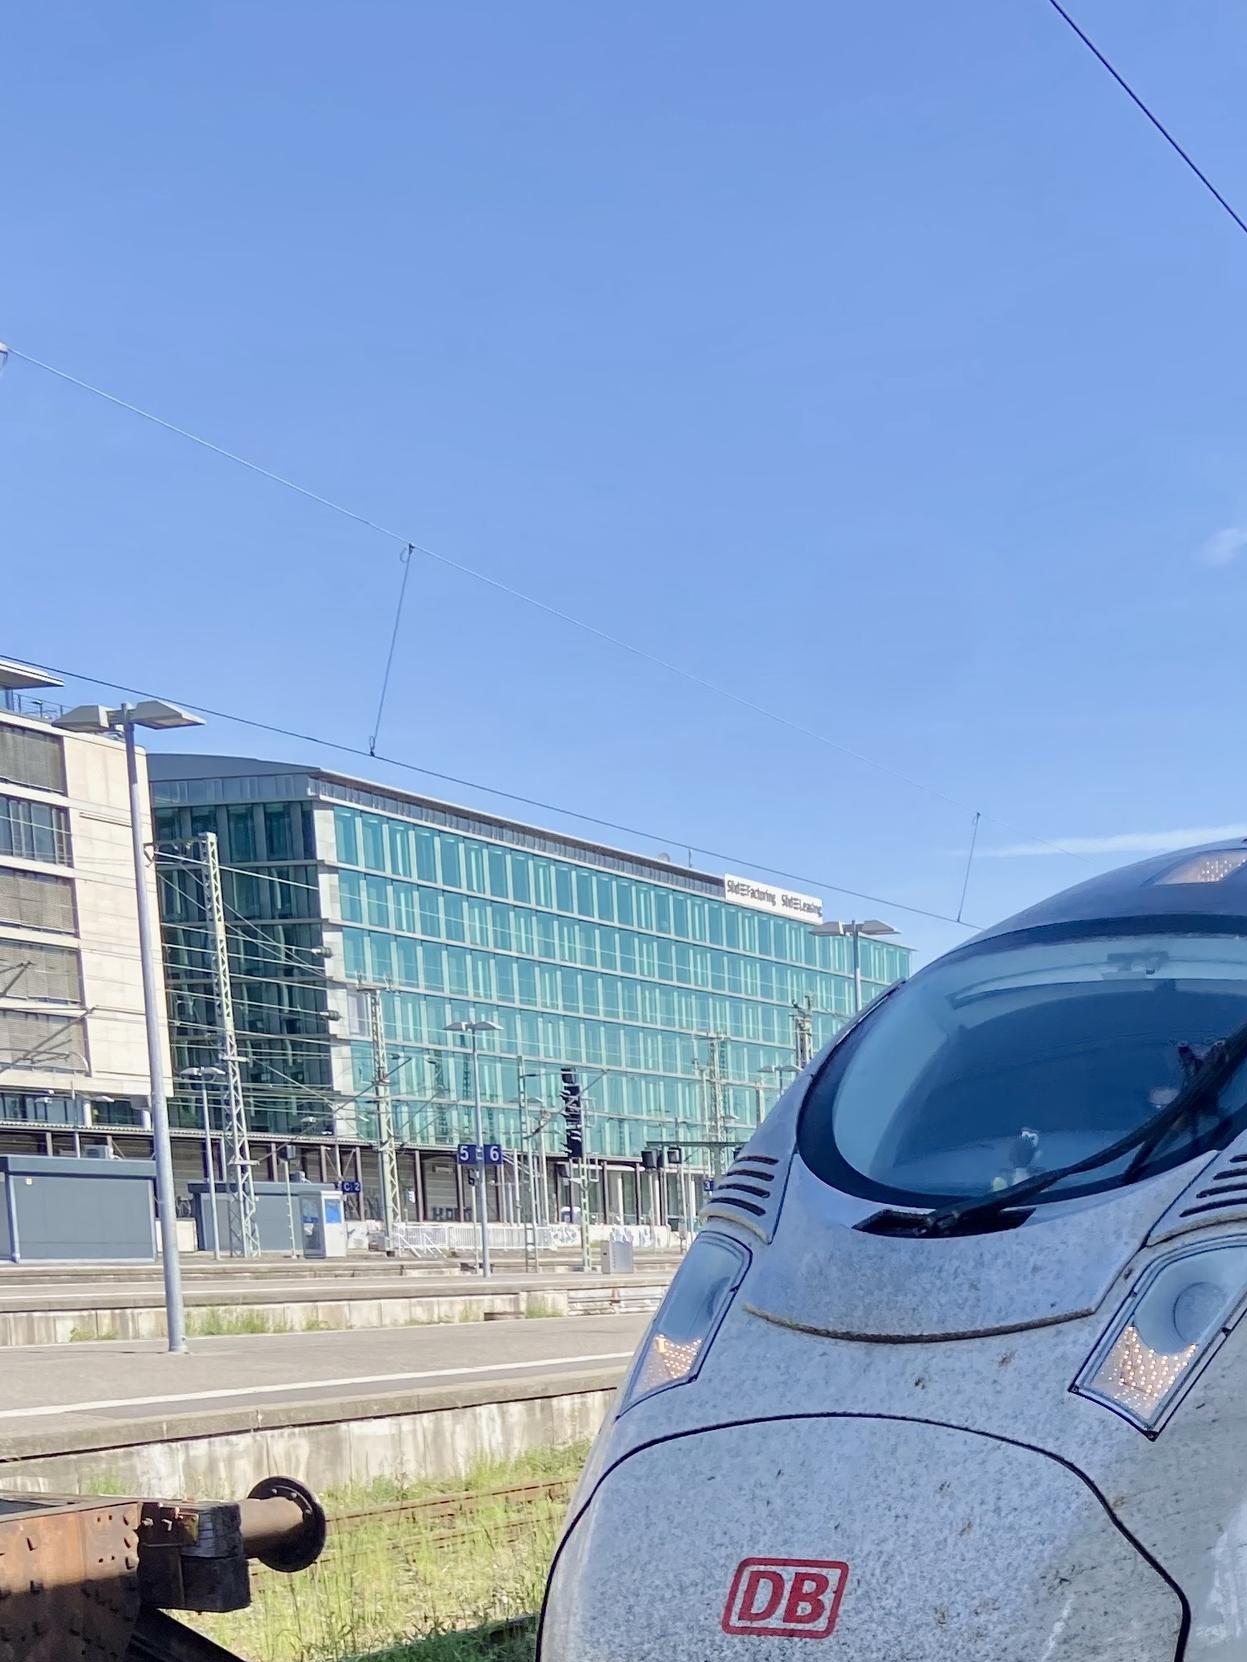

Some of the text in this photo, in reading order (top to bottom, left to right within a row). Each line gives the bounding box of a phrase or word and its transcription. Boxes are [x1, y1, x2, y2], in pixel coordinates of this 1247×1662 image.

[460, 1145, 469, 1161] 5
[490, 1145, 499, 1161] 6
[738, 1570, 829, 1624] DB
